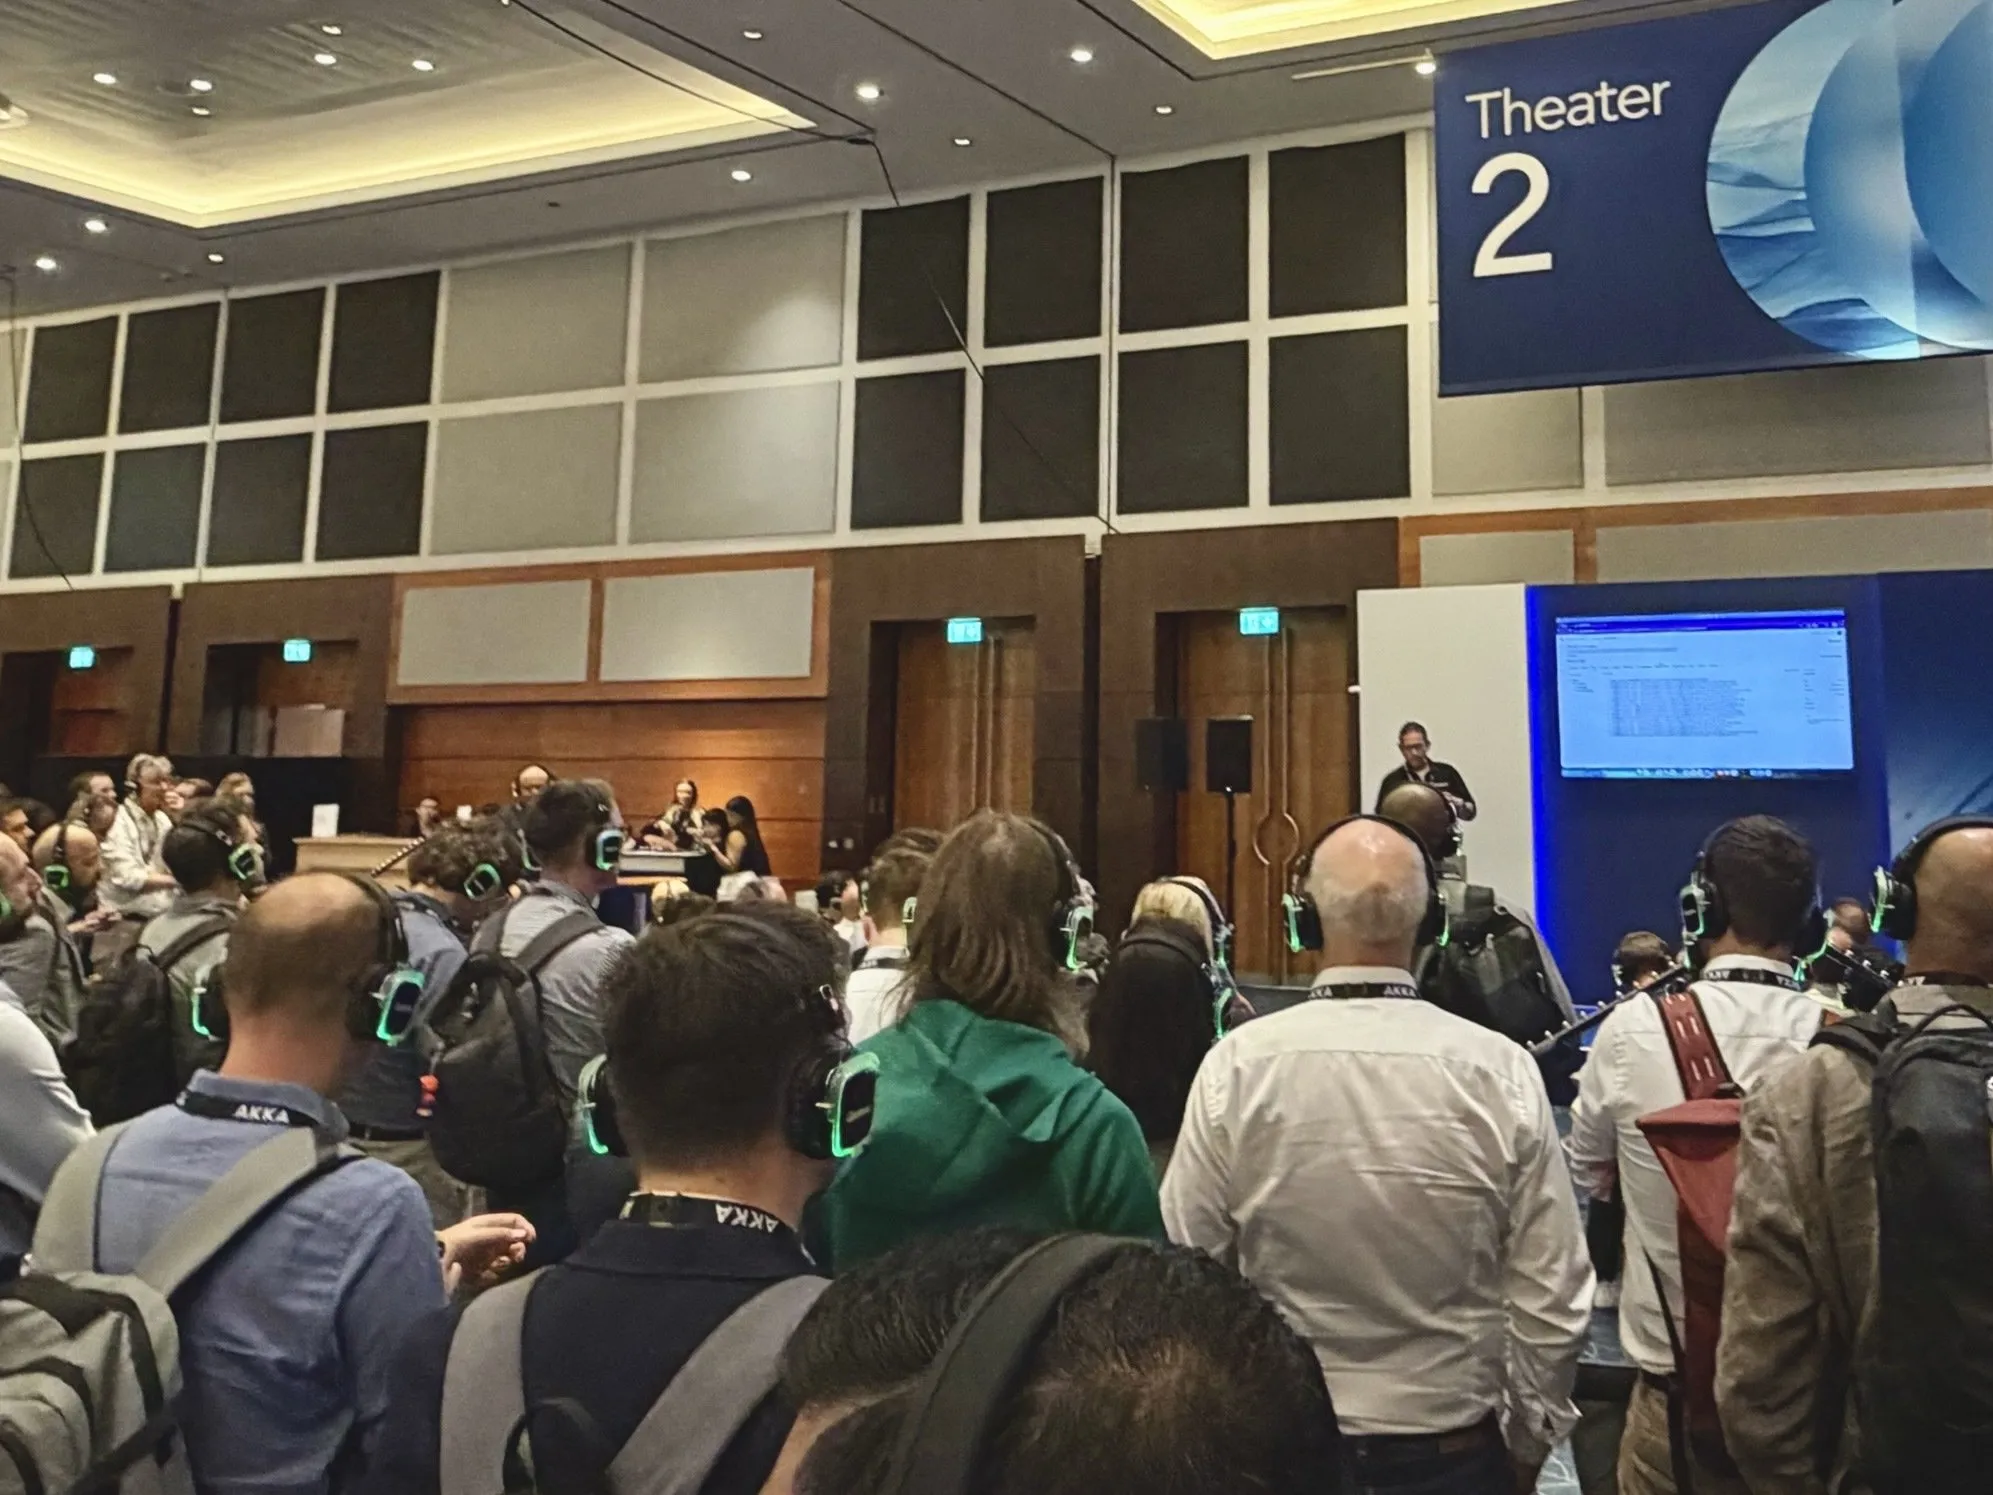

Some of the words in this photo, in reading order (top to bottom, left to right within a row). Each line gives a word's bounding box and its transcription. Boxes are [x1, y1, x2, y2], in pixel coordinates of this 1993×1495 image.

[1465, 80, 1671, 139] Theater
[1471, 151, 1553, 278] 2
[232, 1103, 290, 1124] AKKA
[714, 1202, 780, 1233] AKKA
